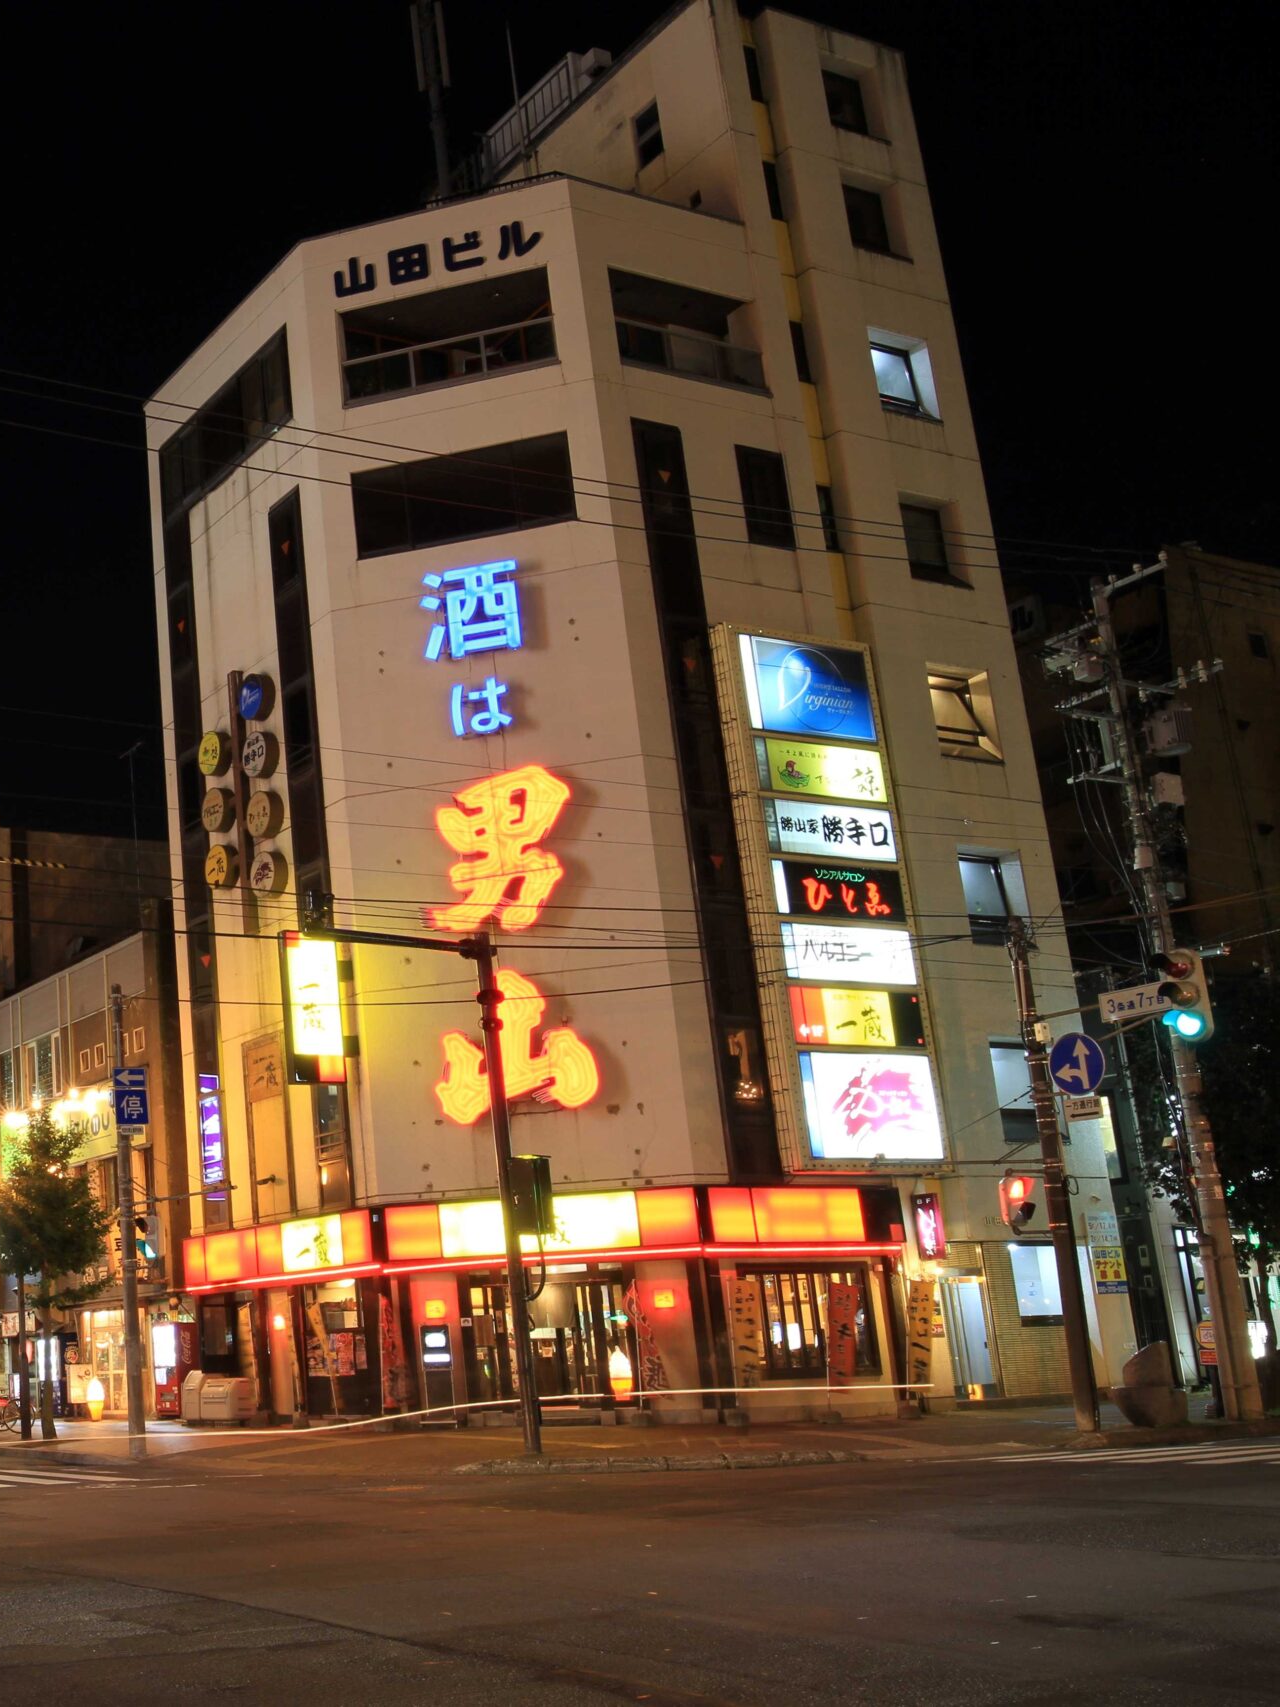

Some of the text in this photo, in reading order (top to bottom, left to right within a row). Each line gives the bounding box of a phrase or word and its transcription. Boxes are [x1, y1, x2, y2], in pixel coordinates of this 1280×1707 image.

[334, 221, 544, 298] 山田ビル
[780, 814, 891, 848] 勝山家 勝手口
[1106, 991, 1166, 1015] 3条通7丁目
[120, 1095, 143, 1119] 停
